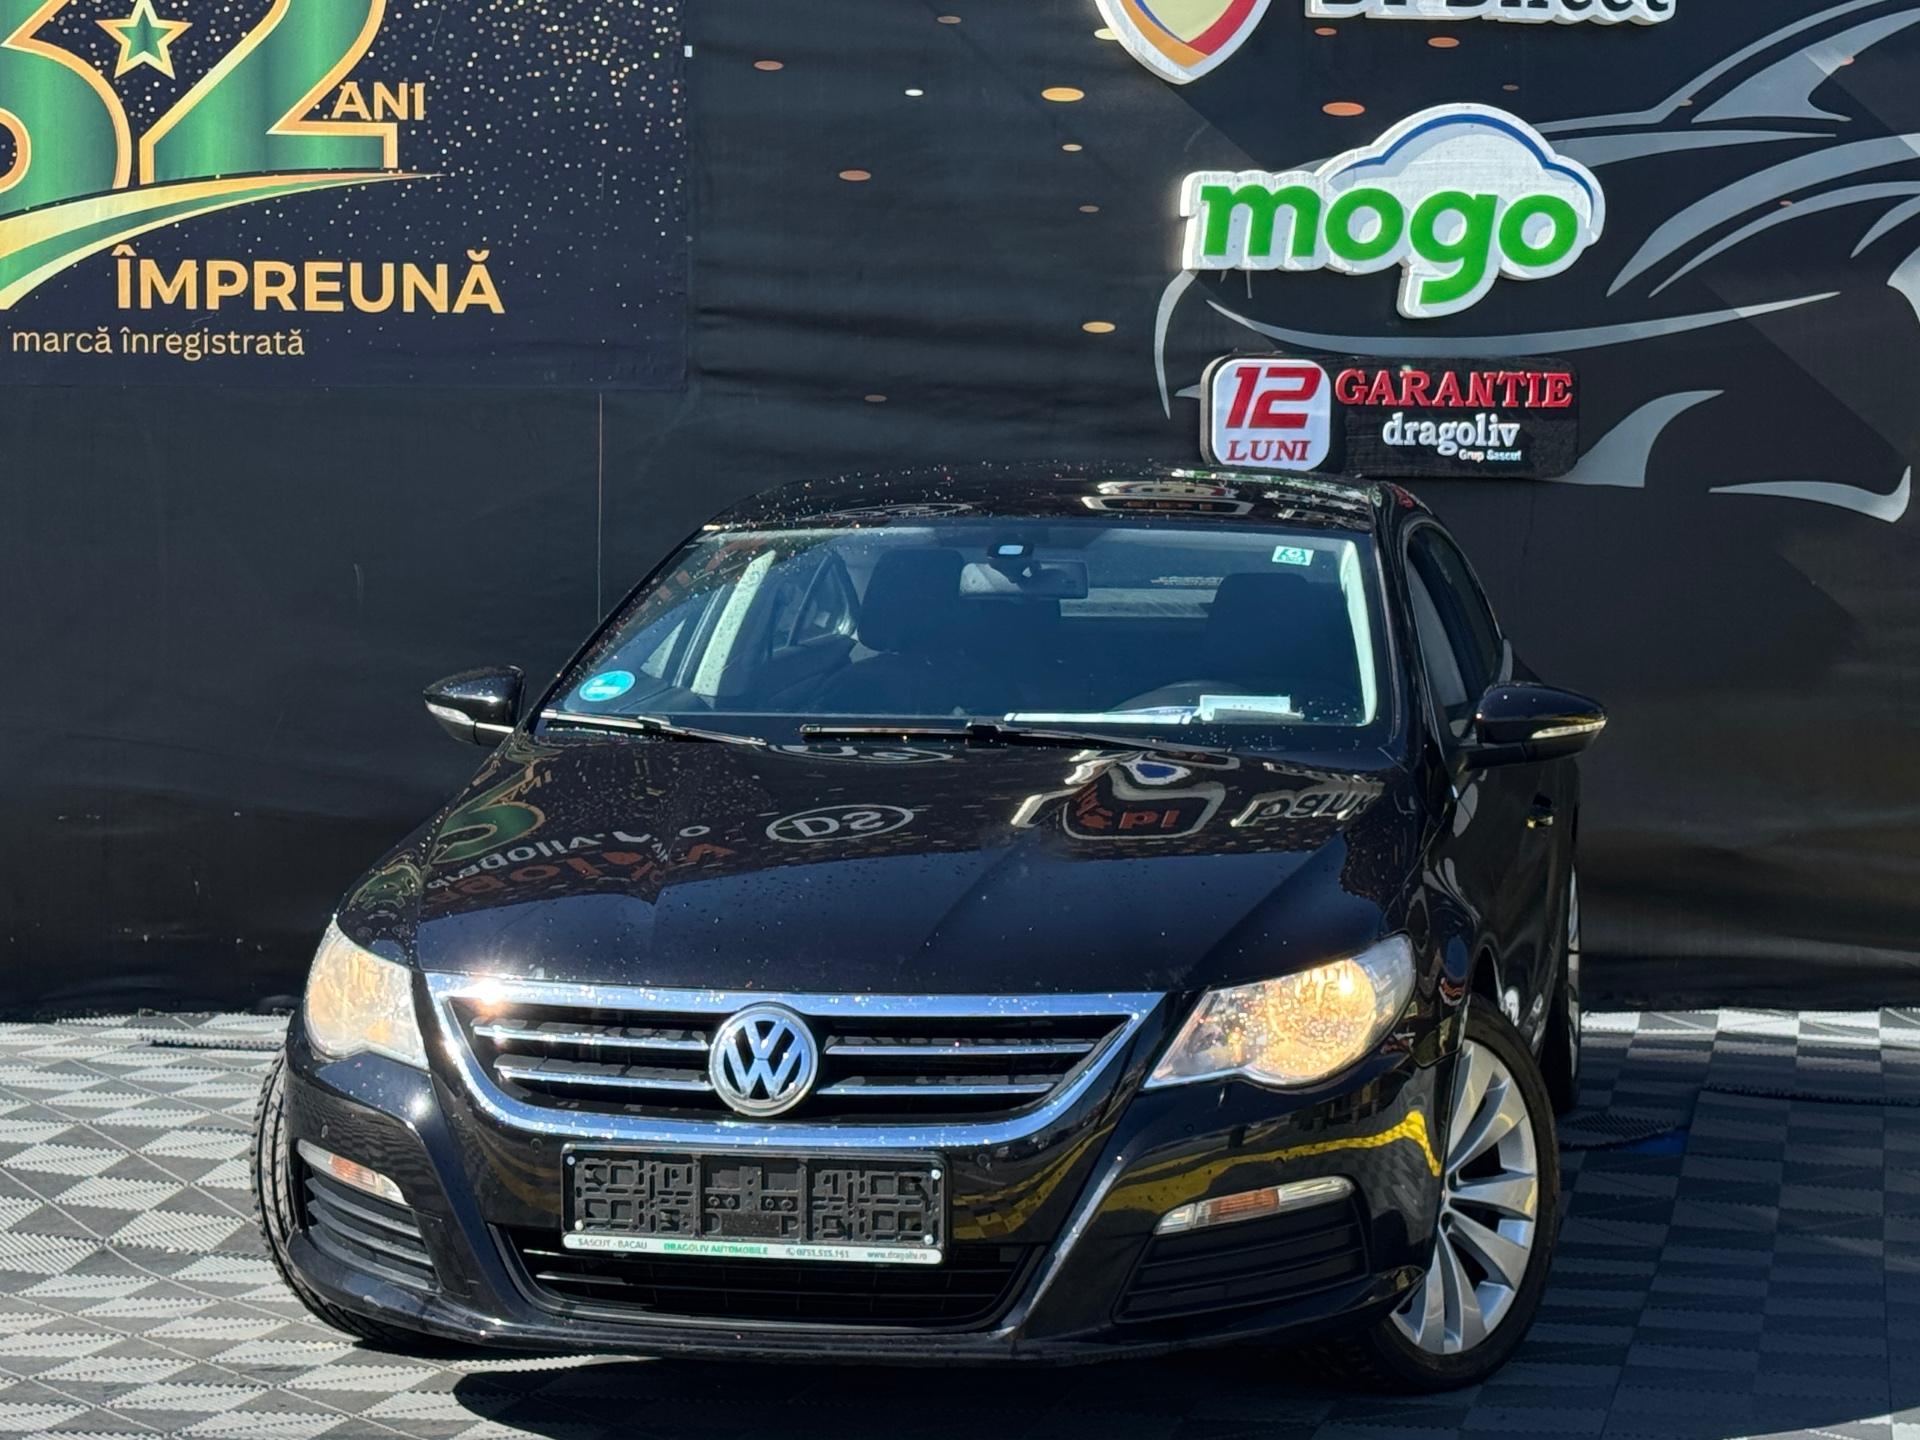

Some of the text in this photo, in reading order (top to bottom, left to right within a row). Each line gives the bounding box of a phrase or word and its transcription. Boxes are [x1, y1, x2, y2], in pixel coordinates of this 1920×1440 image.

[332, 81, 425, 121] ANI
[1200, 184, 1578, 305] mogo
[111, 244, 505, 314] ÎMPREUNĂ
[11, 326, 306, 361] marcă înregistrată
[1226, 366, 1323, 430] 12
[1334, 368, 1574, 408] GARANTIE
[1226, 440, 1312, 462] LUNI
[1382, 412, 1521, 456] dragoliv
[1458, 449, 1522, 463] Grup Sascut
[663, 1242, 709, 1253] DRAGOLIV
[710, 1244, 769, 1255] AUTOMOBILE
